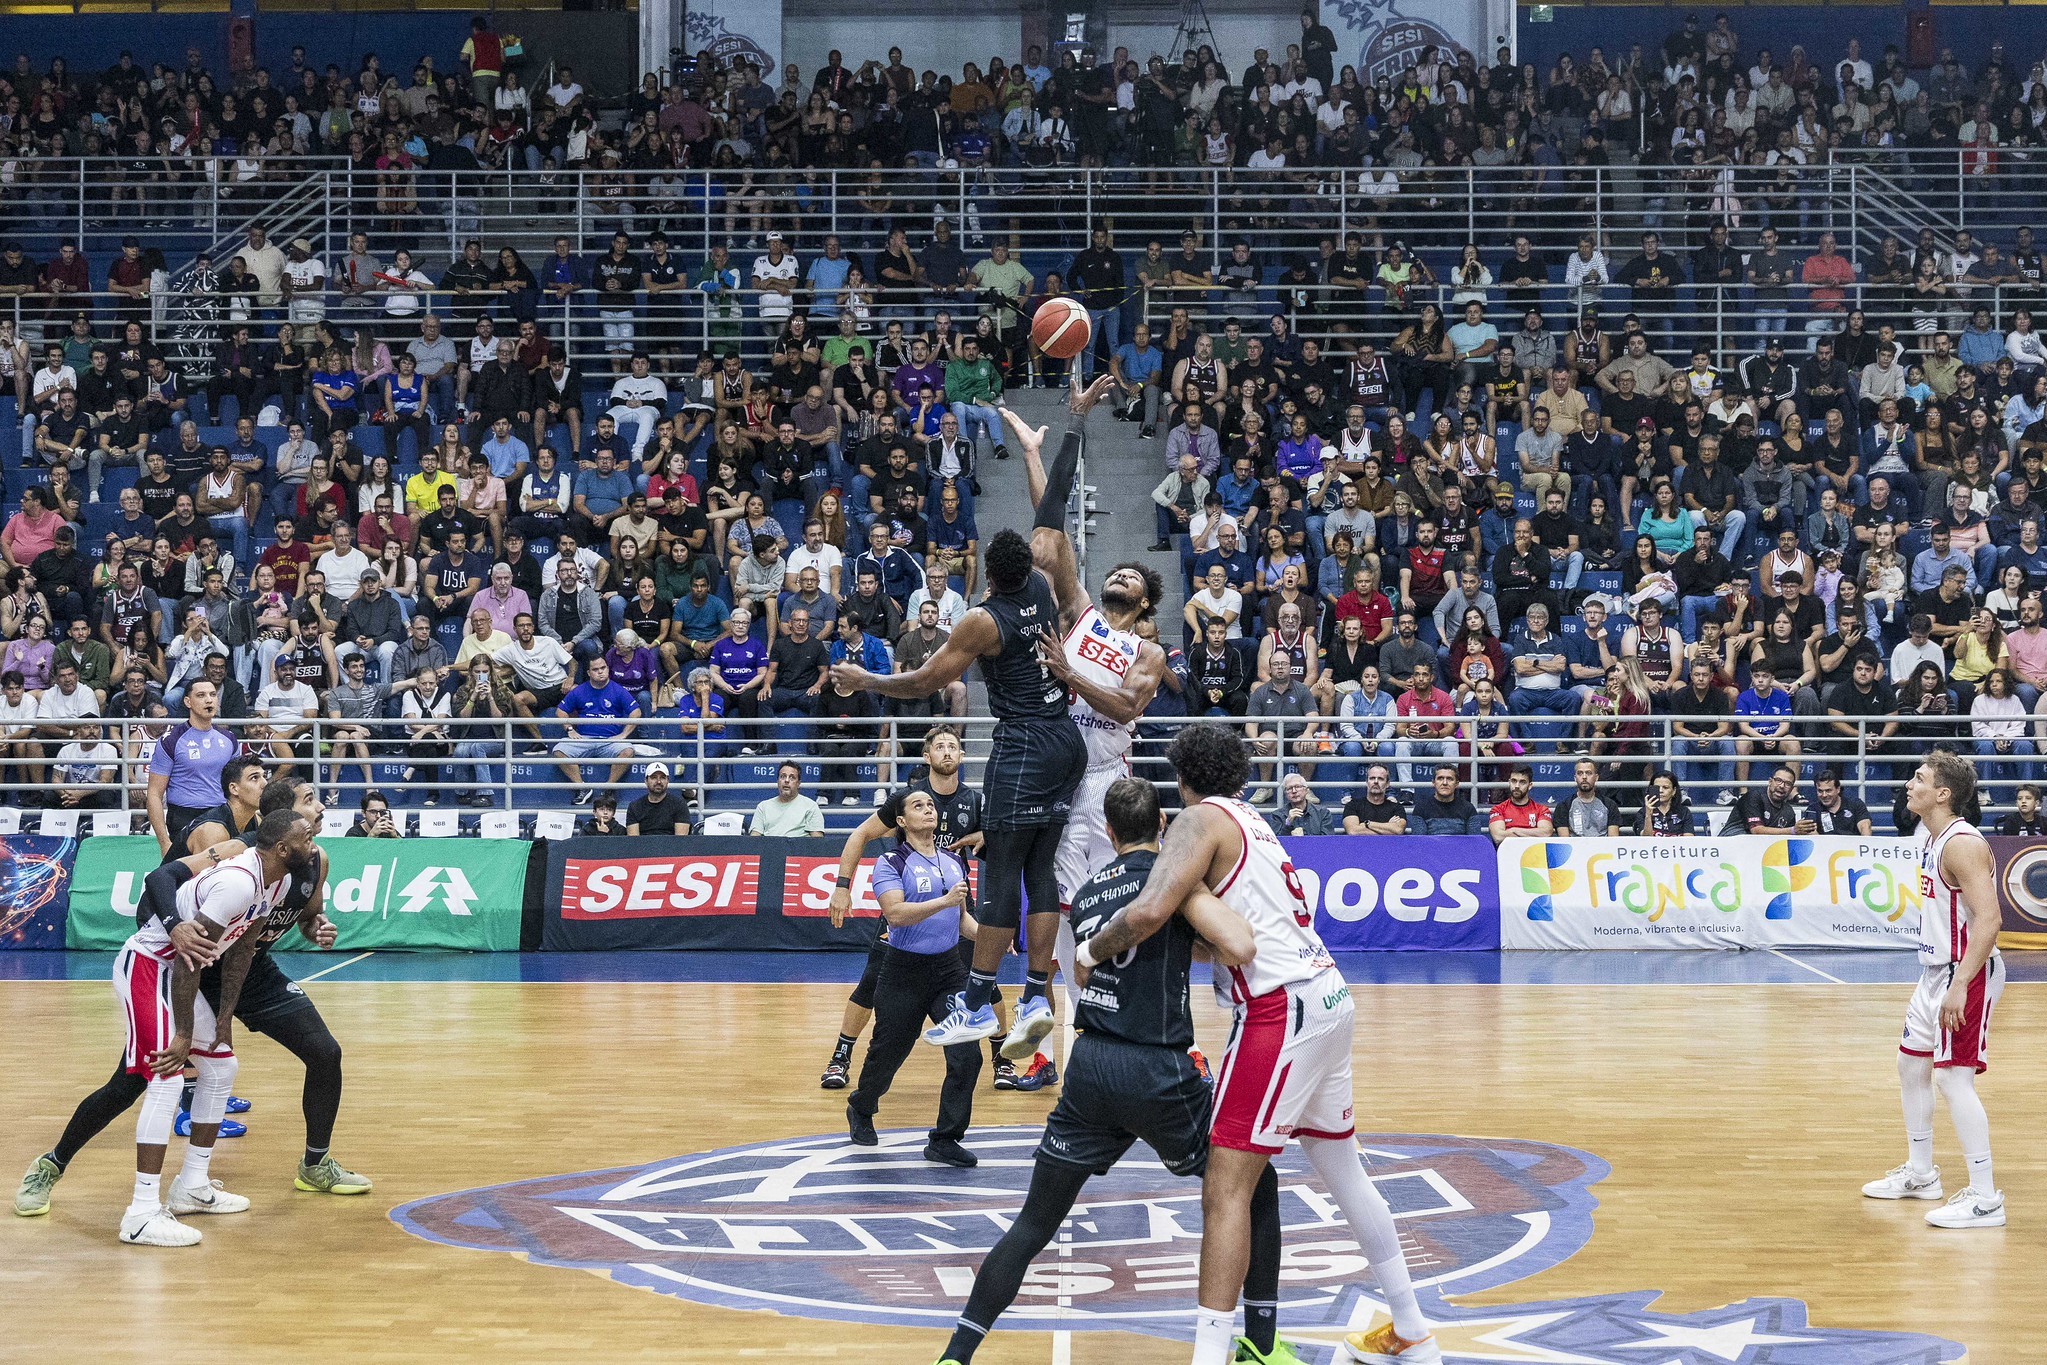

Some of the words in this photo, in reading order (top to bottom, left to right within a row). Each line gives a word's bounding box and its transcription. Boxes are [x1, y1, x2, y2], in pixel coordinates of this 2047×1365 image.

[1381, 30, 1423, 49] SESI
[714, 42, 742, 56] SESI
[1359, 386, 1382, 394] SESI
[1496, 427, 1508, 436] 99
[1808, 427, 1823, 436] 105
[812, 468, 827, 477] 56
[1517, 499, 1534, 508] 246
[1338, 524, 1353, 532] JUST
[1443, 533, 1465, 543] SESI
[1919, 535, 1931, 544] 33
[91, 547, 103, 556] 29
[530, 544, 549, 554] 306
[1451, 544, 1458, 552] 8
[443, 569, 468, 589] USA
[1599, 579, 1618, 589] 398
[1549, 580, 1562, 589] 97
[437, 624, 456, 634] 452
[1085, 640, 1127, 678] SES
[298, 666, 321, 676] SESI
[365, 669, 379, 679] 21
[631, 764, 647, 774] 66
[754, 765, 775, 776] 662
[1538, 764, 1561, 776] 672
[55, 820, 67, 828] NBB
[107, 822, 120, 830] NBB
[432, 820, 446, 828] NBB
[718, 821, 731, 829] NBB
[1617, 845, 1720, 861] Prefeitura
[1092, 863, 1126, 884] CAIXA
[579, 861, 742, 913] SESI
[1078, 894, 1099, 911] VON
[1102, 880, 1140, 901] HAYDIN
[1281, 862, 1311, 928] 9
[1594, 926, 1643, 937] Moderna,
[1645, 924, 1686, 935] vibrante
[1698, 923, 1744, 935] inclusiva.
[1832, 922, 1881, 935] Moderna,
[1884, 922, 1921, 935] vibrant
